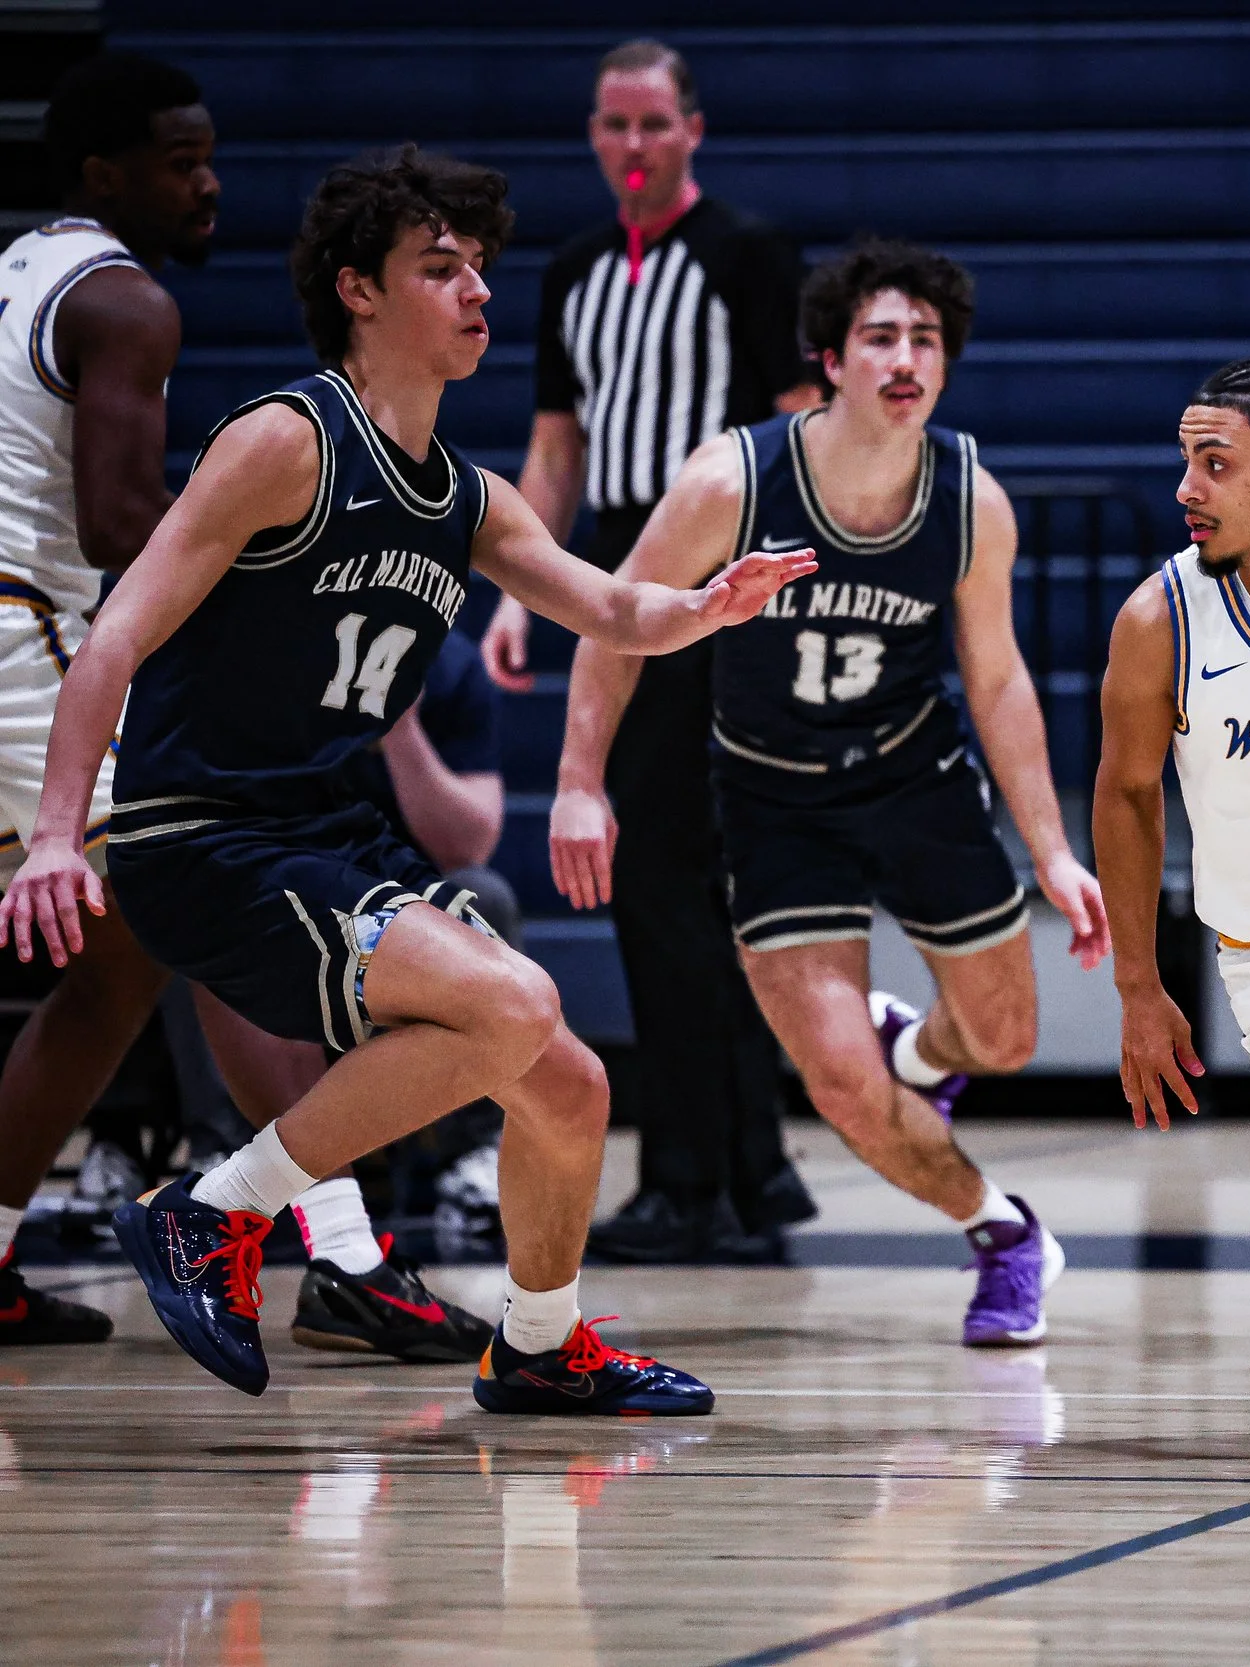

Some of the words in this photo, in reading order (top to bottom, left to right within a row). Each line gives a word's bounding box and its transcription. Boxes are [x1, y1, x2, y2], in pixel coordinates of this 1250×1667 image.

[313, 554, 369, 594] CAL
[368, 550, 466, 630] MARITIME
[760, 586, 797, 619] AL
[807, 581, 937, 626] MARITIM
[320, 612, 417, 719] 14
[792, 628, 886, 705] 13
